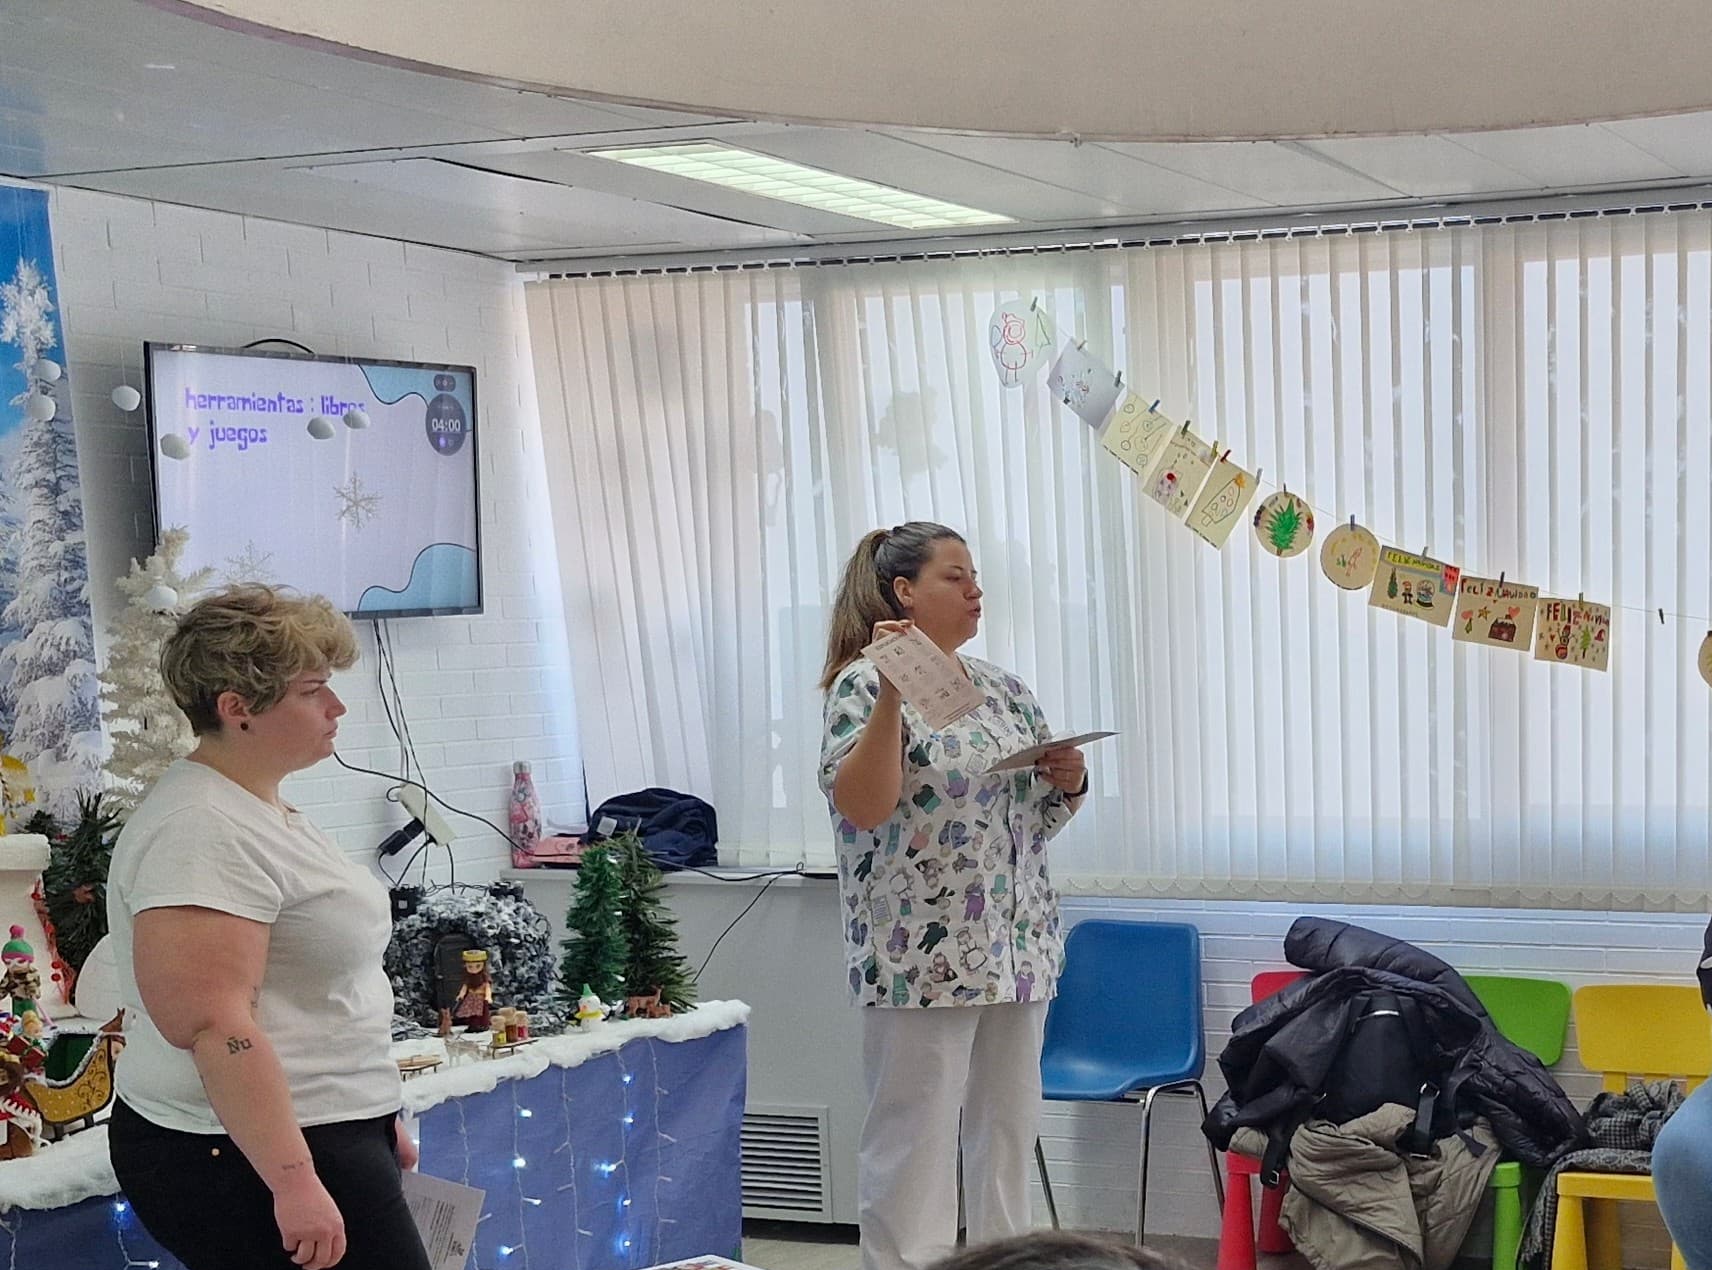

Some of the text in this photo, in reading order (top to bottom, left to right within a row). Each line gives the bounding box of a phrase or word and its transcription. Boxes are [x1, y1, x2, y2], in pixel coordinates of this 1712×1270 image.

[185, 387, 304, 414] herramientas
[188, 420, 268, 451] y juegos
[432, 418, 461, 432] 04:00
